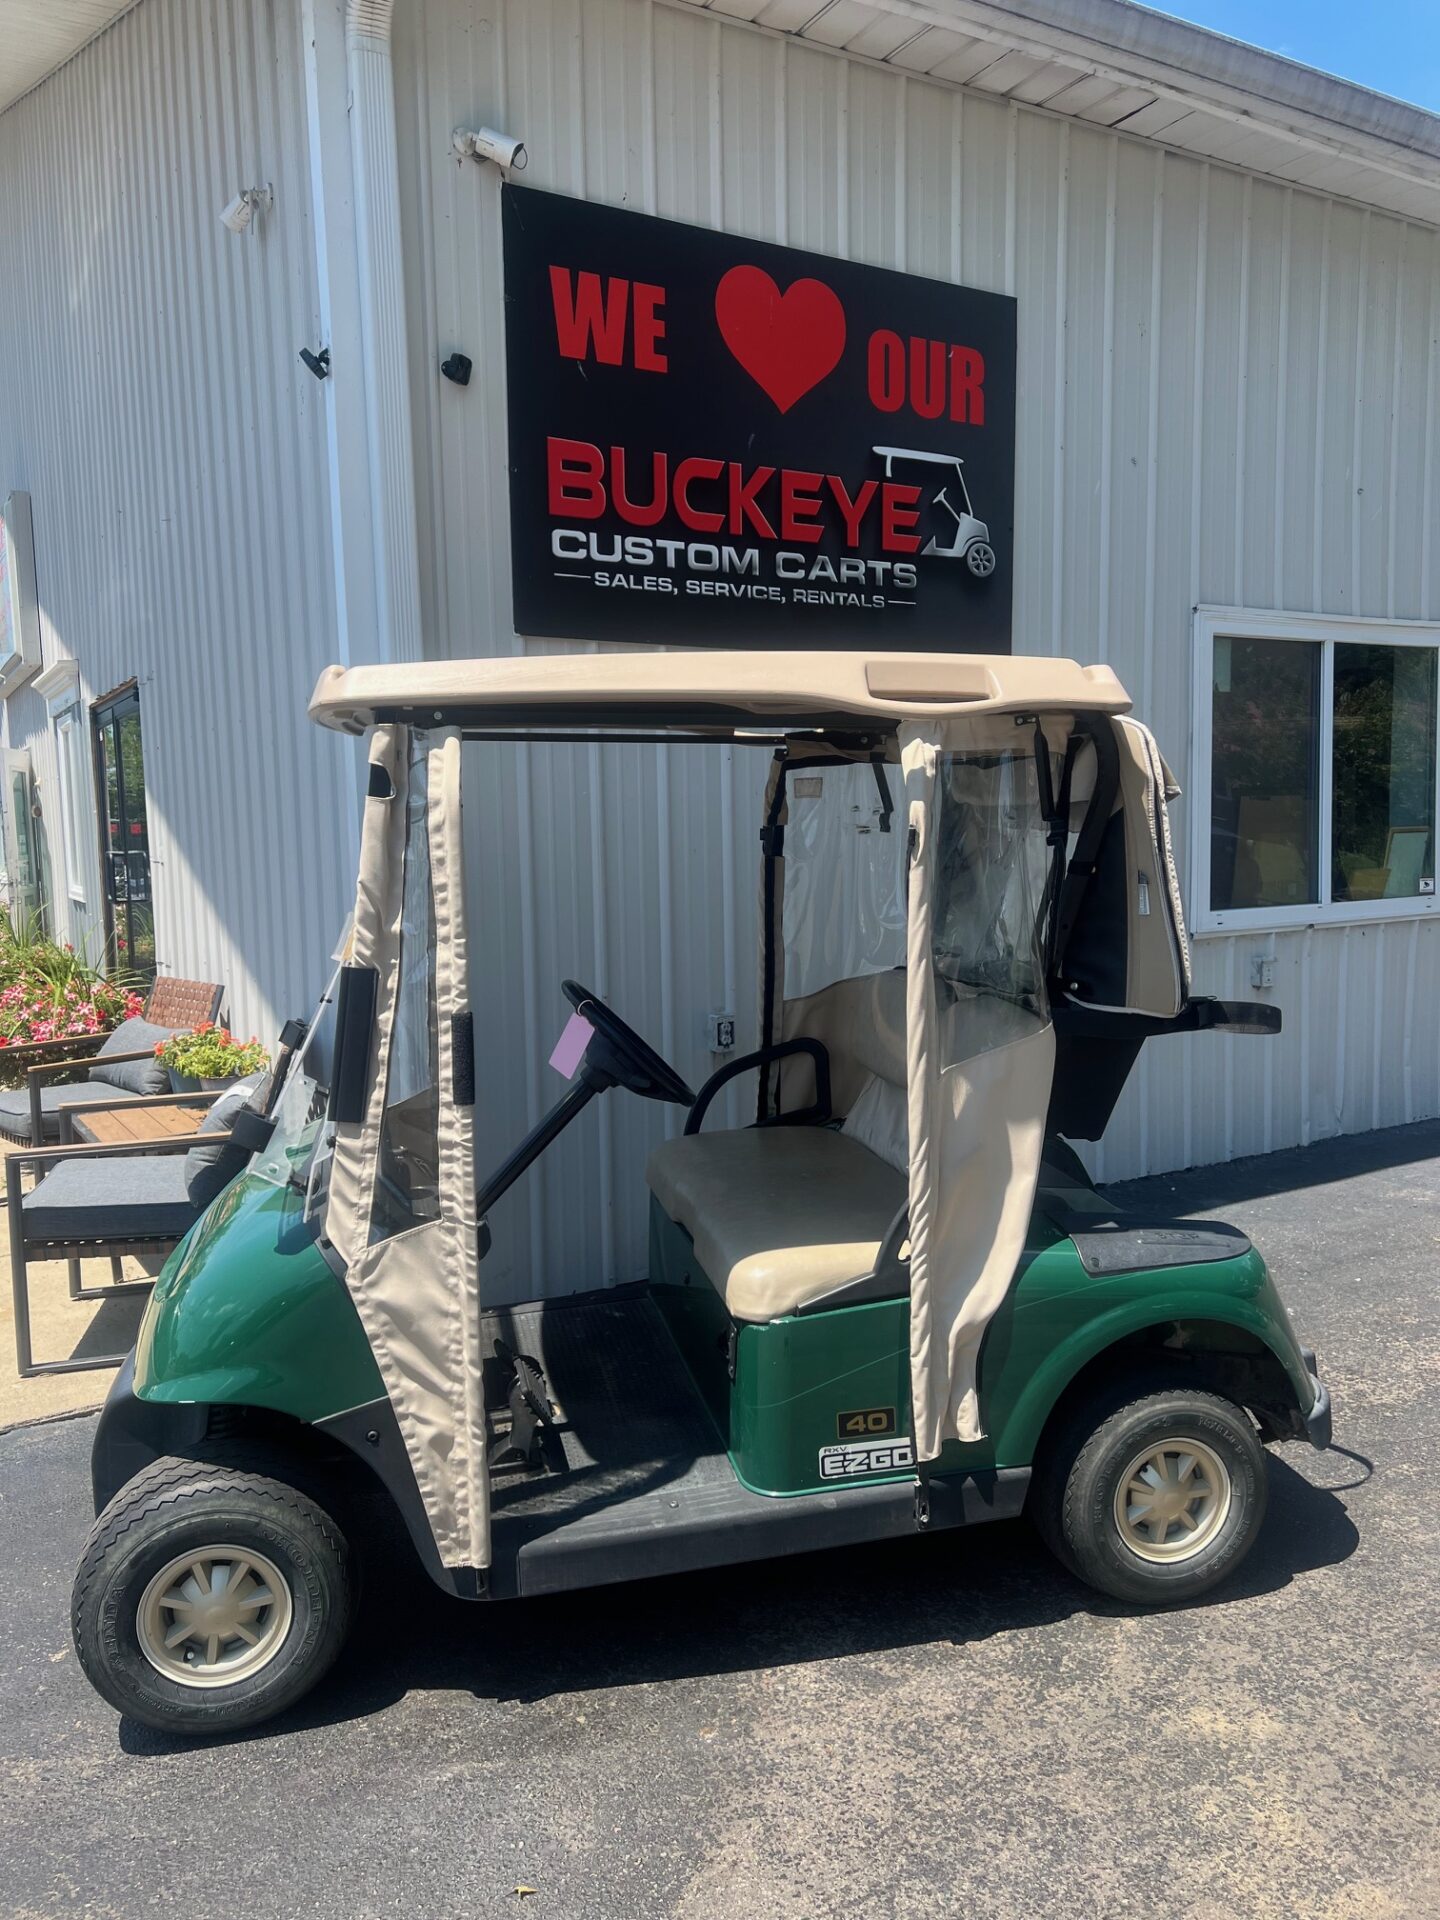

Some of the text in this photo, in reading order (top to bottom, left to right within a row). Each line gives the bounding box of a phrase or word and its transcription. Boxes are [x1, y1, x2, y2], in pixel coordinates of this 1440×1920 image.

[549, 265, 985, 426] WE OUR
[547, 436, 922, 553] BUCKEYE
[551, 529, 917, 589] CUSTOM CARTS
[594, 571, 885, 608] SALES, SERVICE, RENTALS
[846, 1412, 888, 1433] 40
[823, 1446, 848, 1454] RXV
